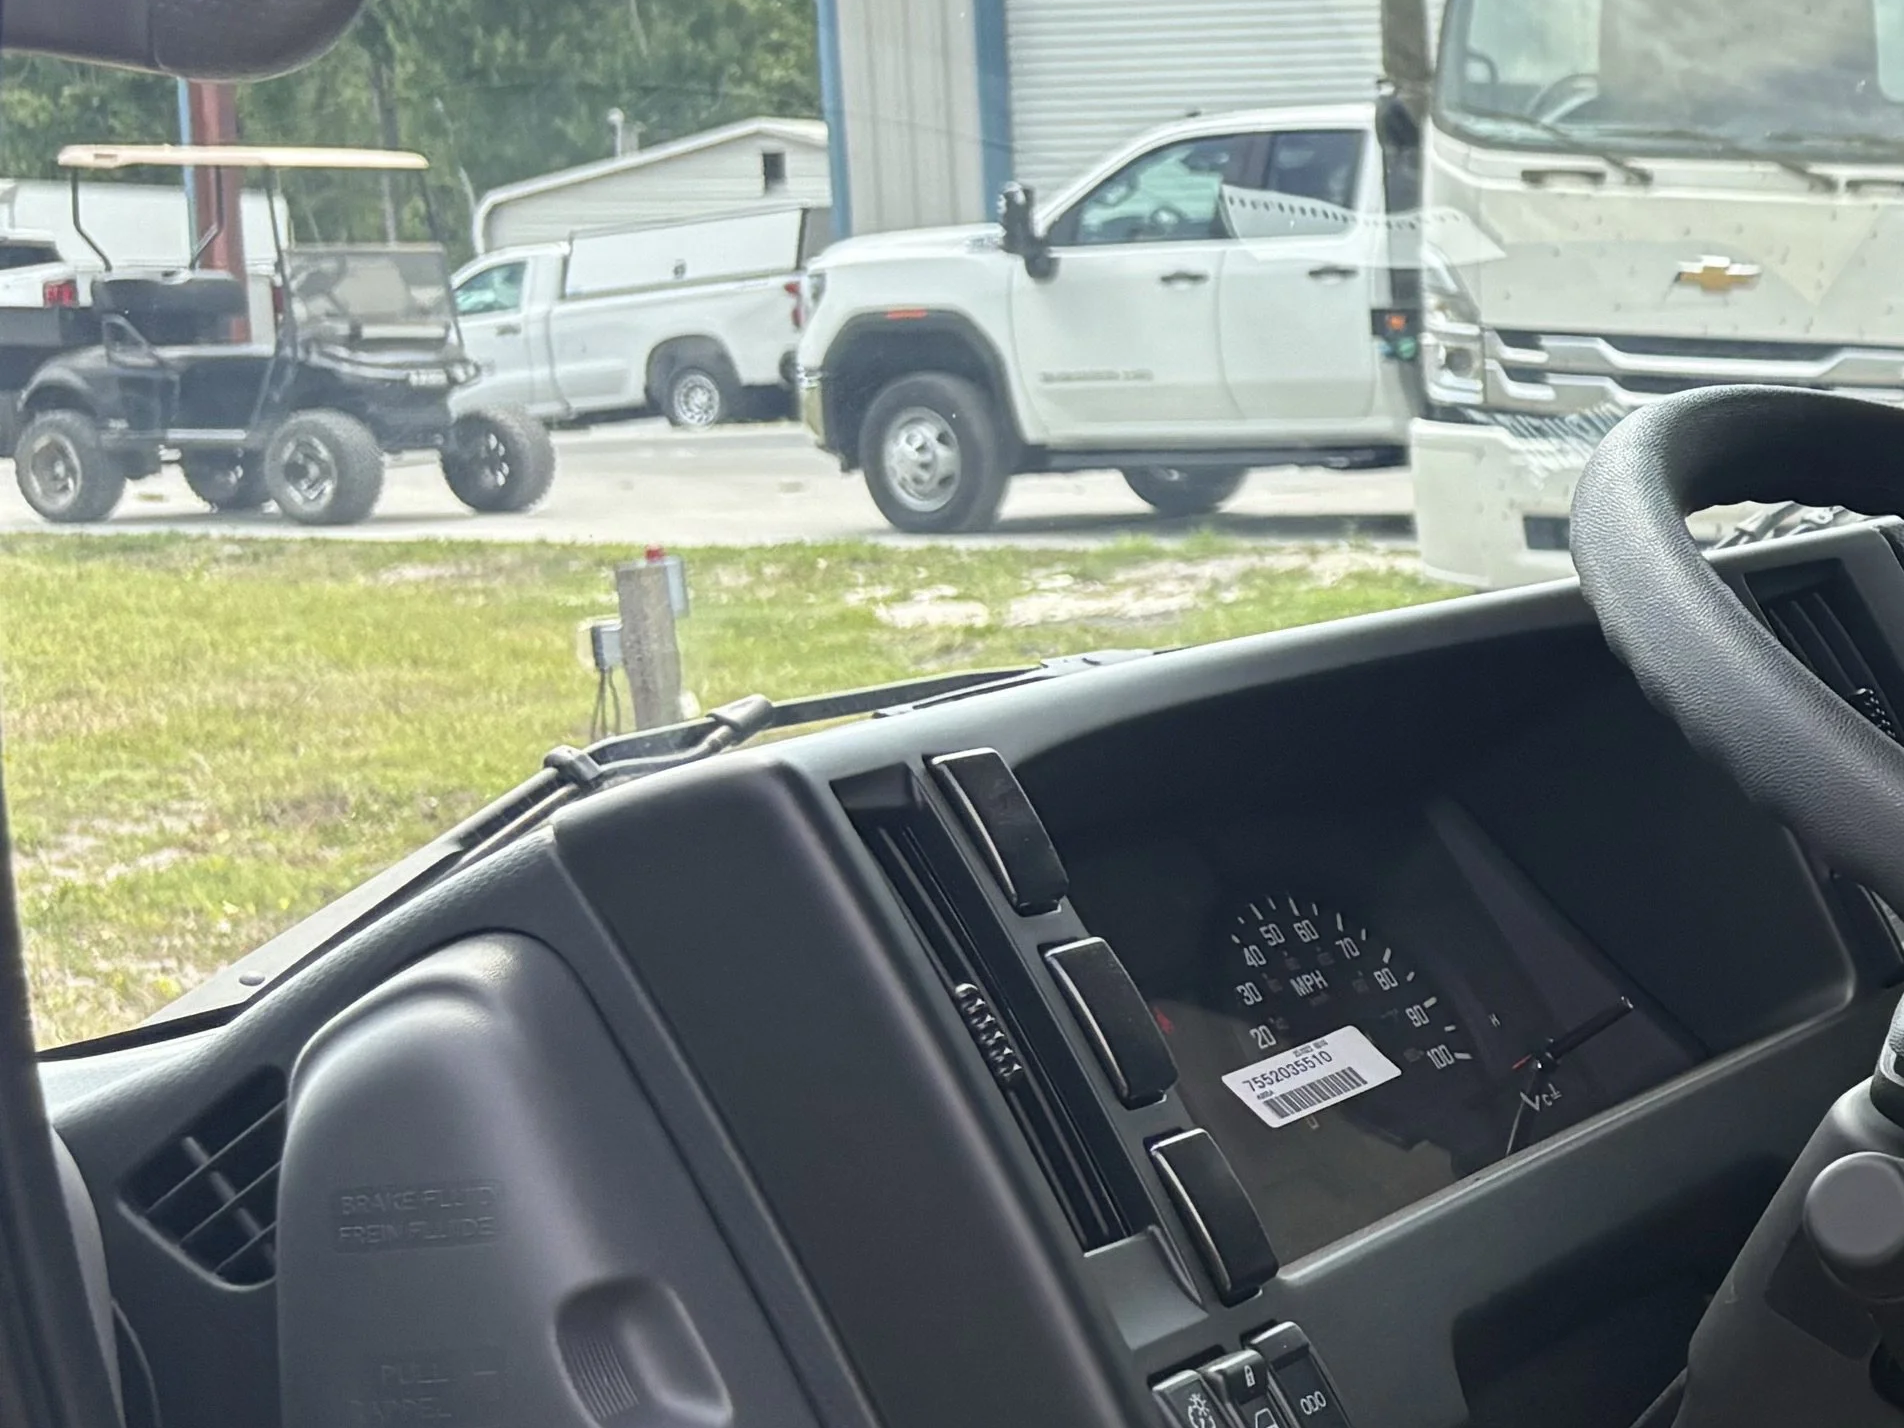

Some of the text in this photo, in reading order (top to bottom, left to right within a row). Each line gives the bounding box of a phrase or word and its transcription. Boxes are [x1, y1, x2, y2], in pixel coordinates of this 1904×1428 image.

[1258, 923, 1286, 947] 50
[1293, 919, 1320, 943] 60
[1243, 944, 1268, 968] 40
[1334, 937, 1361, 960] 70
[1289, 969, 1329, 997] MPH
[1373, 967, 1399, 991] 80
[1236, 981, 1263, 1006] 30
[1405, 1004, 1430, 1028] 90
[1250, 1024, 1277, 1050] 20
[1426, 1044, 1456, 1070] 100
[1241, 1050, 1334, 1093] 7552035510
[340, 1185, 498, 1216] BRAKE FLUID
[338, 1223, 400, 1245] FREIN
[380, 1362, 450, 1387] PULL
[1300, 1390, 1327, 1416] ODO
